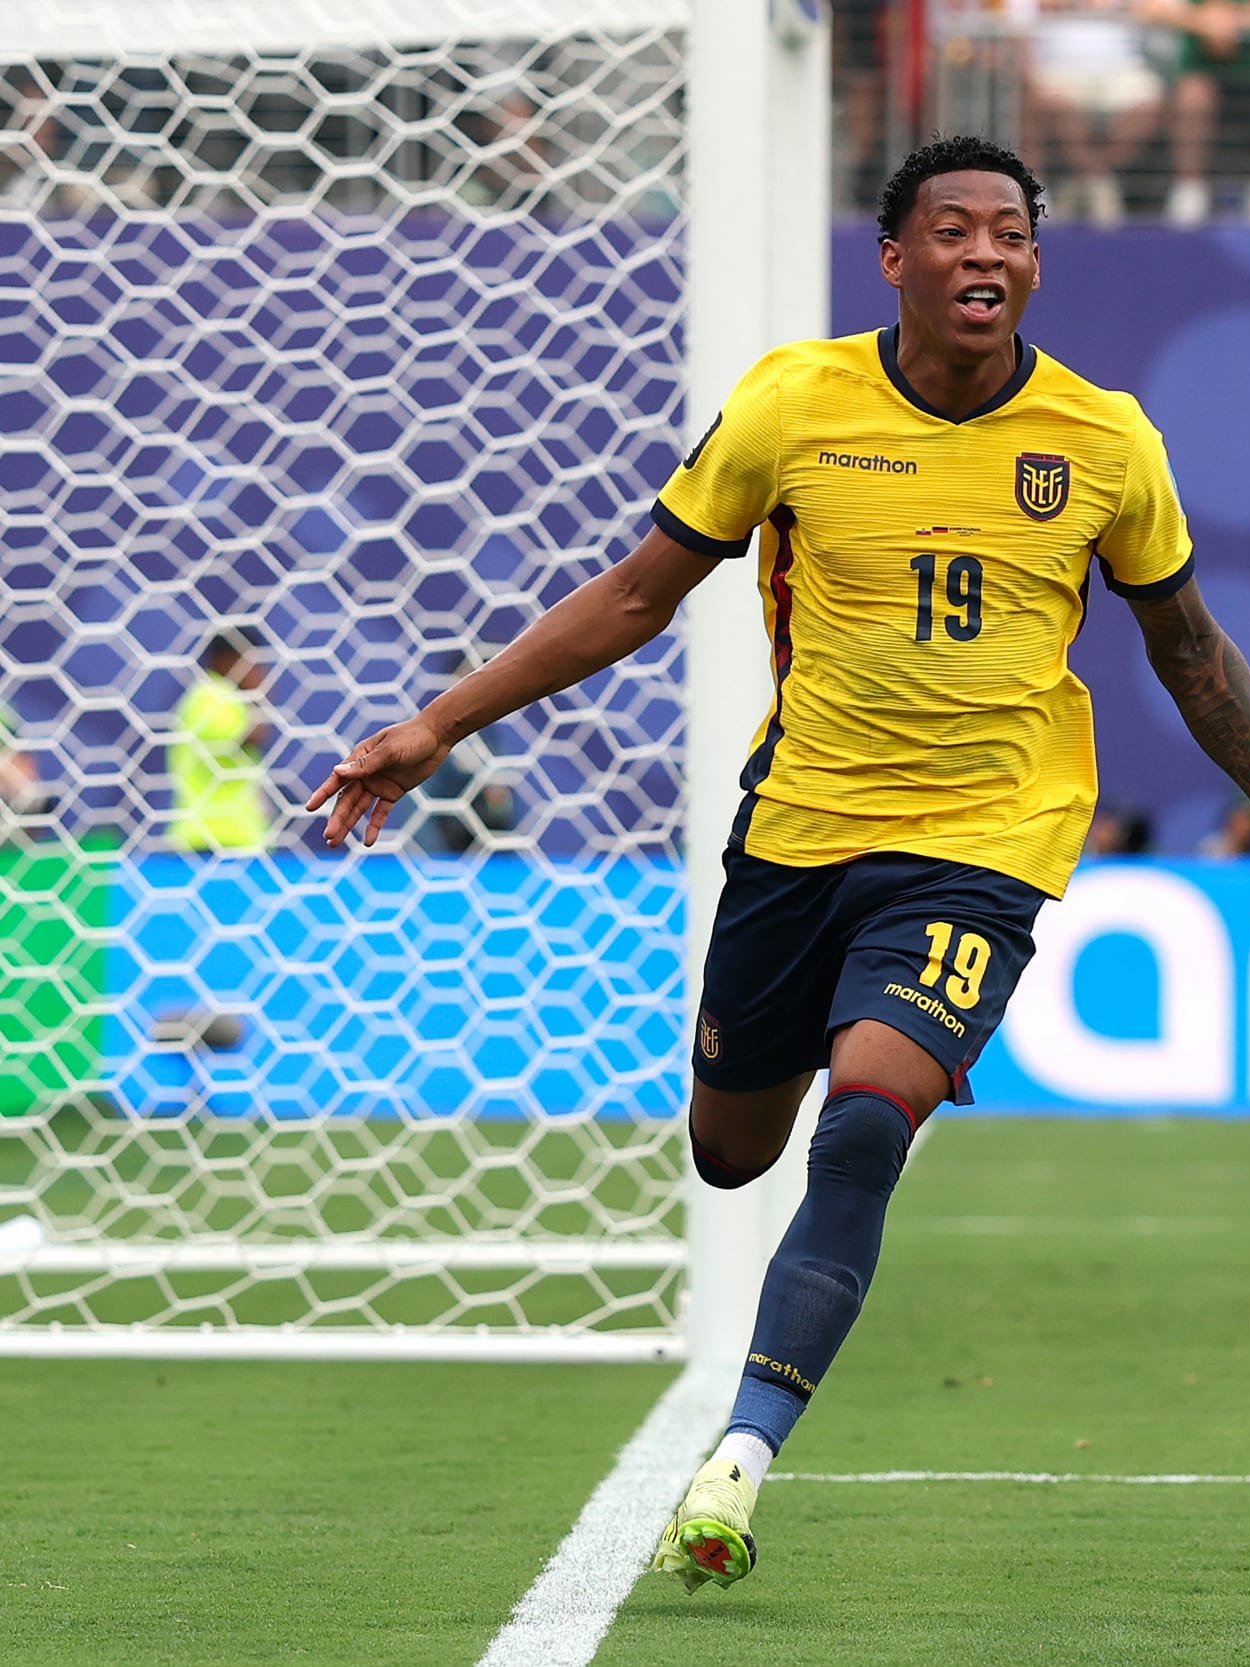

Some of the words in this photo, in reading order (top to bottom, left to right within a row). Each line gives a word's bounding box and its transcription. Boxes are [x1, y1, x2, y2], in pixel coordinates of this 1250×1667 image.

[819, 451, 917, 475] marathon
[910, 554, 984, 642] 19
[919, 921, 992, 1010] 19
[883, 982, 966, 1039] marathon
[748, 1353, 817, 1393] marathon
